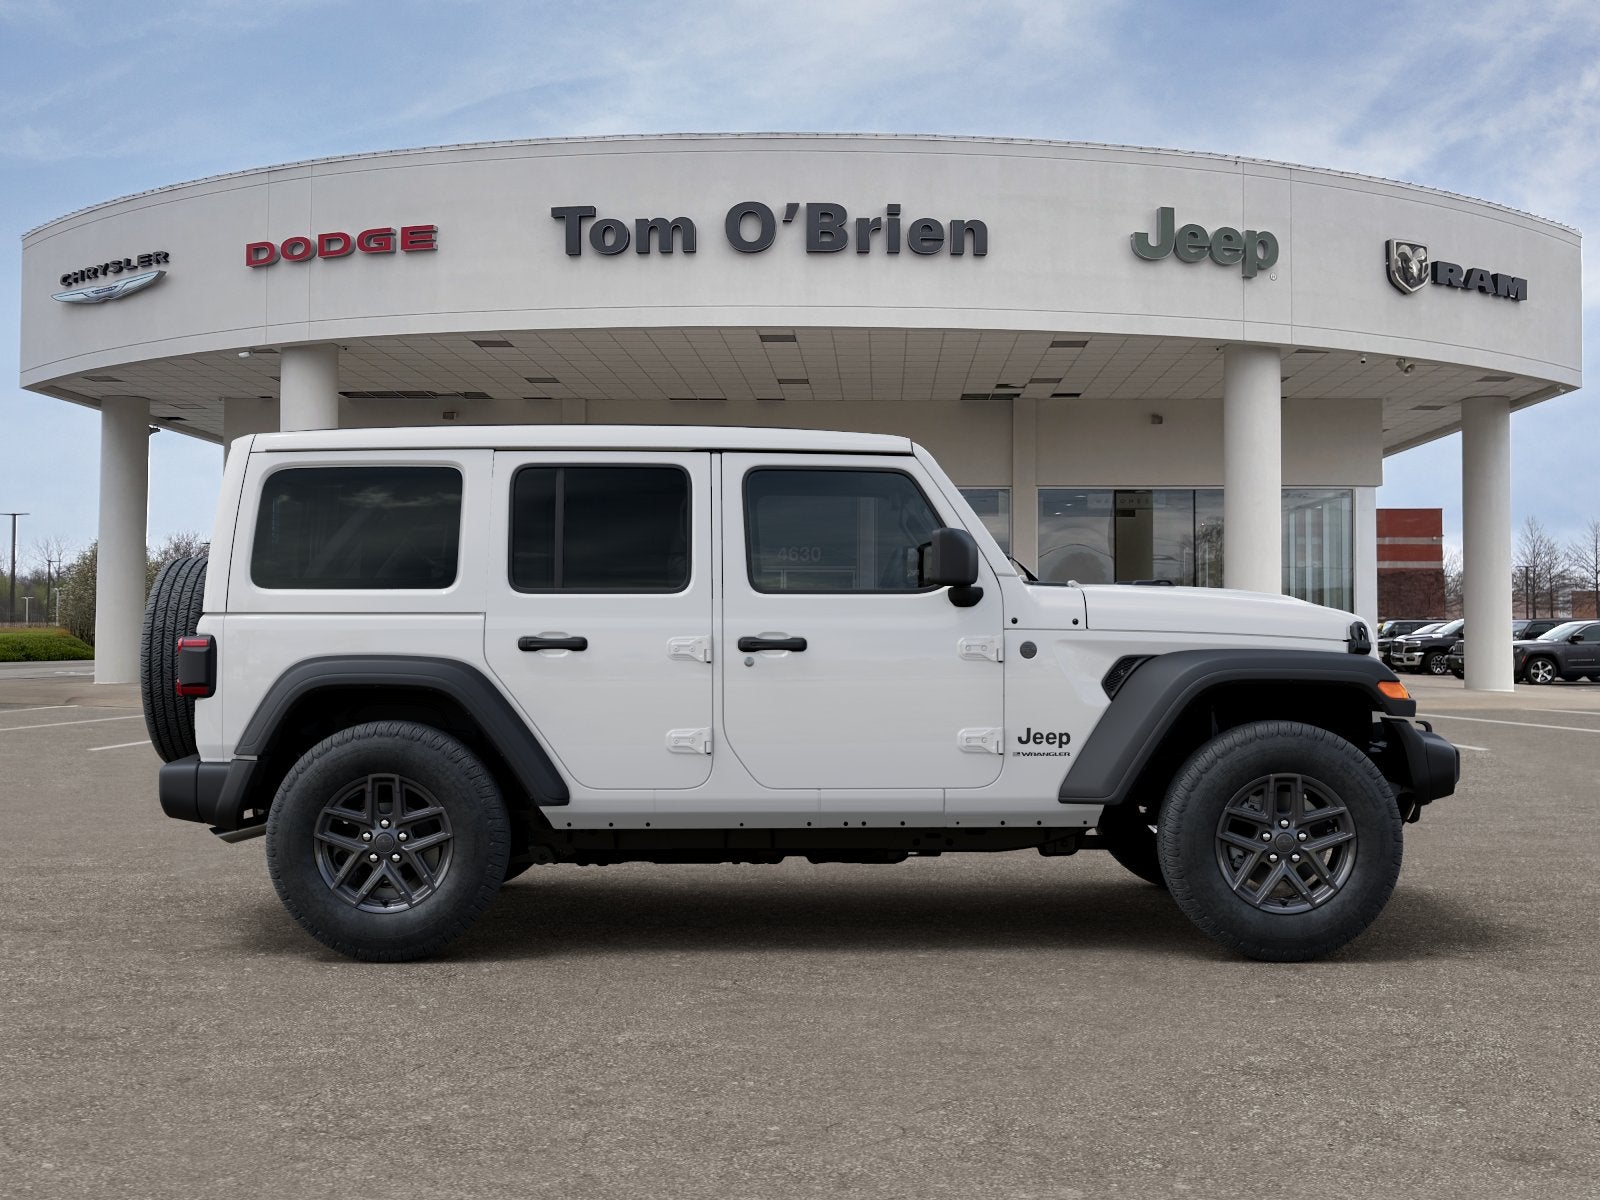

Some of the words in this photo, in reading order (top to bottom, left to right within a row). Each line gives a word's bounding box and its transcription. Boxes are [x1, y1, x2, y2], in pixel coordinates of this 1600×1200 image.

[245, 224, 438, 268] DODGE
[551, 205, 697, 256] Tom
[725, 201, 989, 256] O'Brien
[1131, 207, 1279, 278] Jeep
[60, 249, 170, 287] CHRYSLER
[1431, 260, 1528, 301] RAM
[776, 546, 822, 562] 4630
[1017, 727, 1071, 749] Jeep
